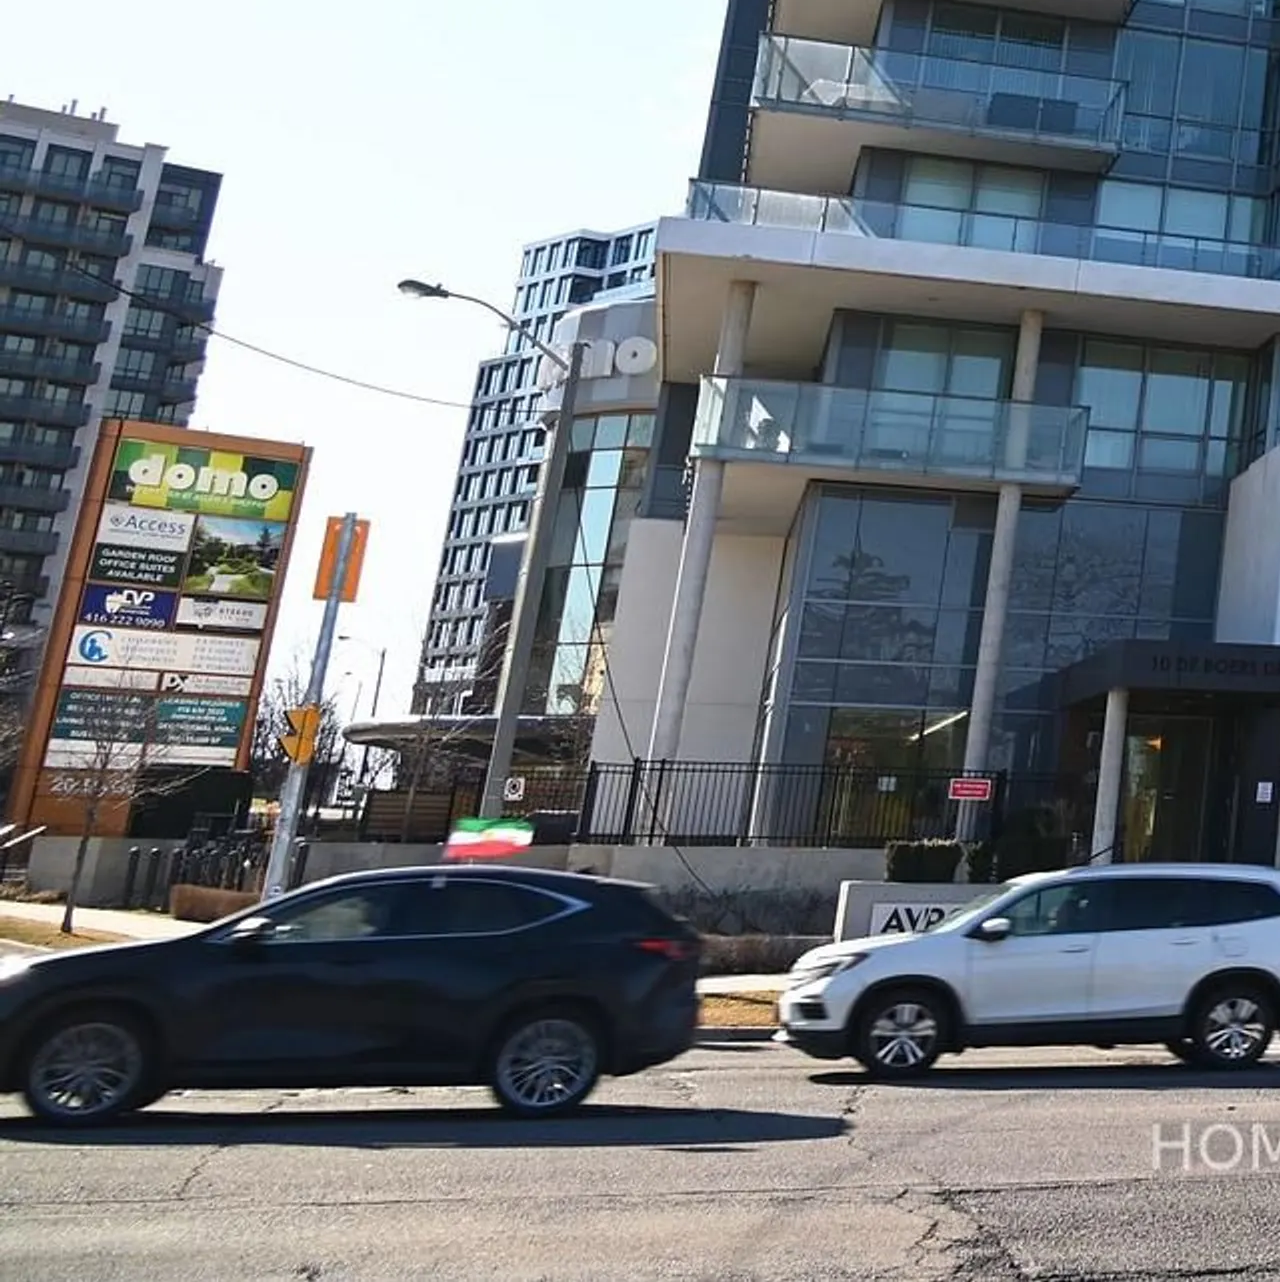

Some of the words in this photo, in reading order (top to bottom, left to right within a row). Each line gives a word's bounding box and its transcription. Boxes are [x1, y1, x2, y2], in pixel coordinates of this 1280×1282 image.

[128, 454, 279, 500] domo
[126, 515, 186, 535] Access
[102, 548, 147, 560] GARDEN
[148, 554, 177, 563] ROOF
[99, 558, 137, 569] OFFICE
[138, 562, 176, 573] SUITES
[107, 569, 165, 582] AVAILABLE
